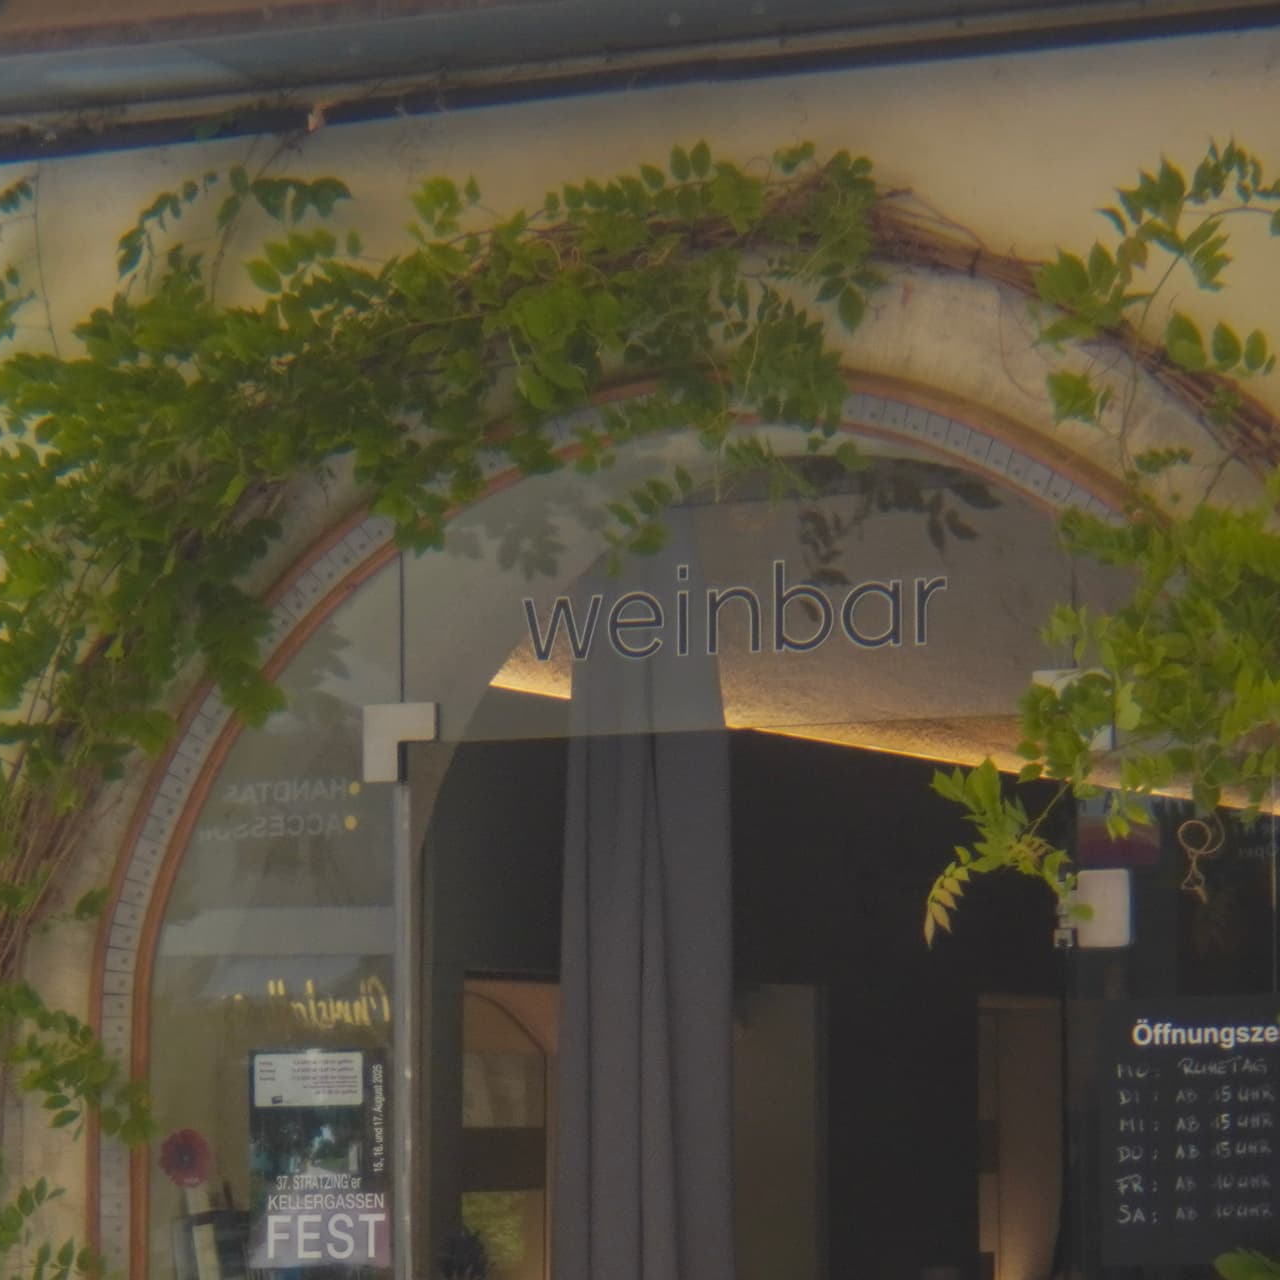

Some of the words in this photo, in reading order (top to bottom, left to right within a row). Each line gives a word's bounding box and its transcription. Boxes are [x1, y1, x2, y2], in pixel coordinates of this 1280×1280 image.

[522, 560, 948, 661] weinbar
[372, 1063, 384, 1084] 2025
[372, 1085, 386, 1113] August
[372, 1127, 384, 1143] und
[276, 1175, 291, 1191] 37.
[268, 1193, 384, 1210] KELLERGASSEN
[267, 1213, 385, 1259] FEST
